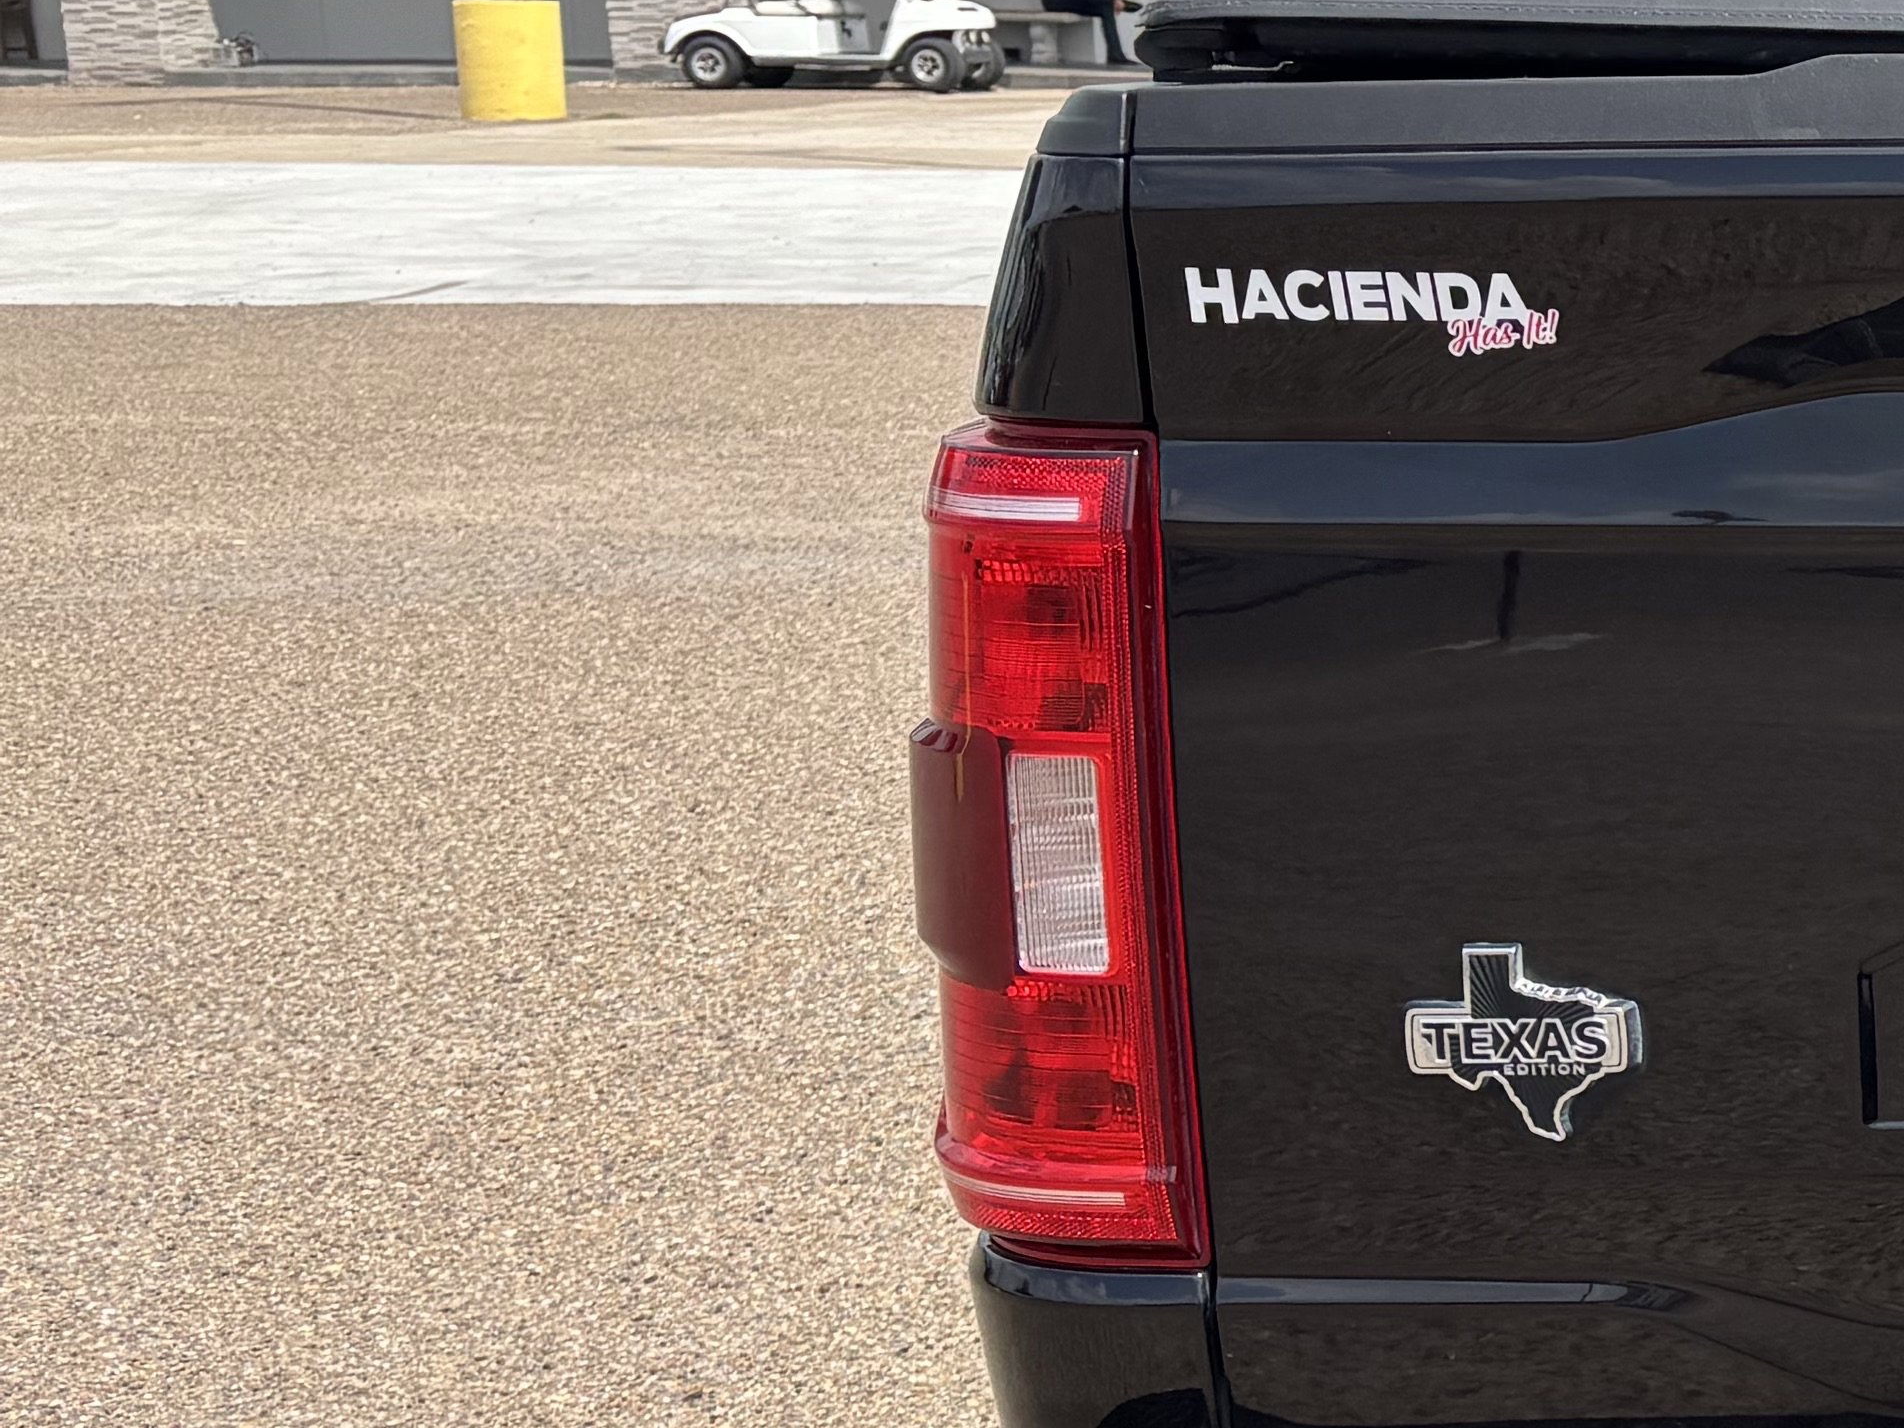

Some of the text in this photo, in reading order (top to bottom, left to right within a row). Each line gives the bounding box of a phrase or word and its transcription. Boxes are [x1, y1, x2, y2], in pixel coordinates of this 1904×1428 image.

[1184, 267, 1531, 325] HACIENDA
[1447, 308, 1559, 357] Has It!
[1420, 1017, 1612, 1065] TEXAS
[1503, 1063, 1586, 1077] EDITION
